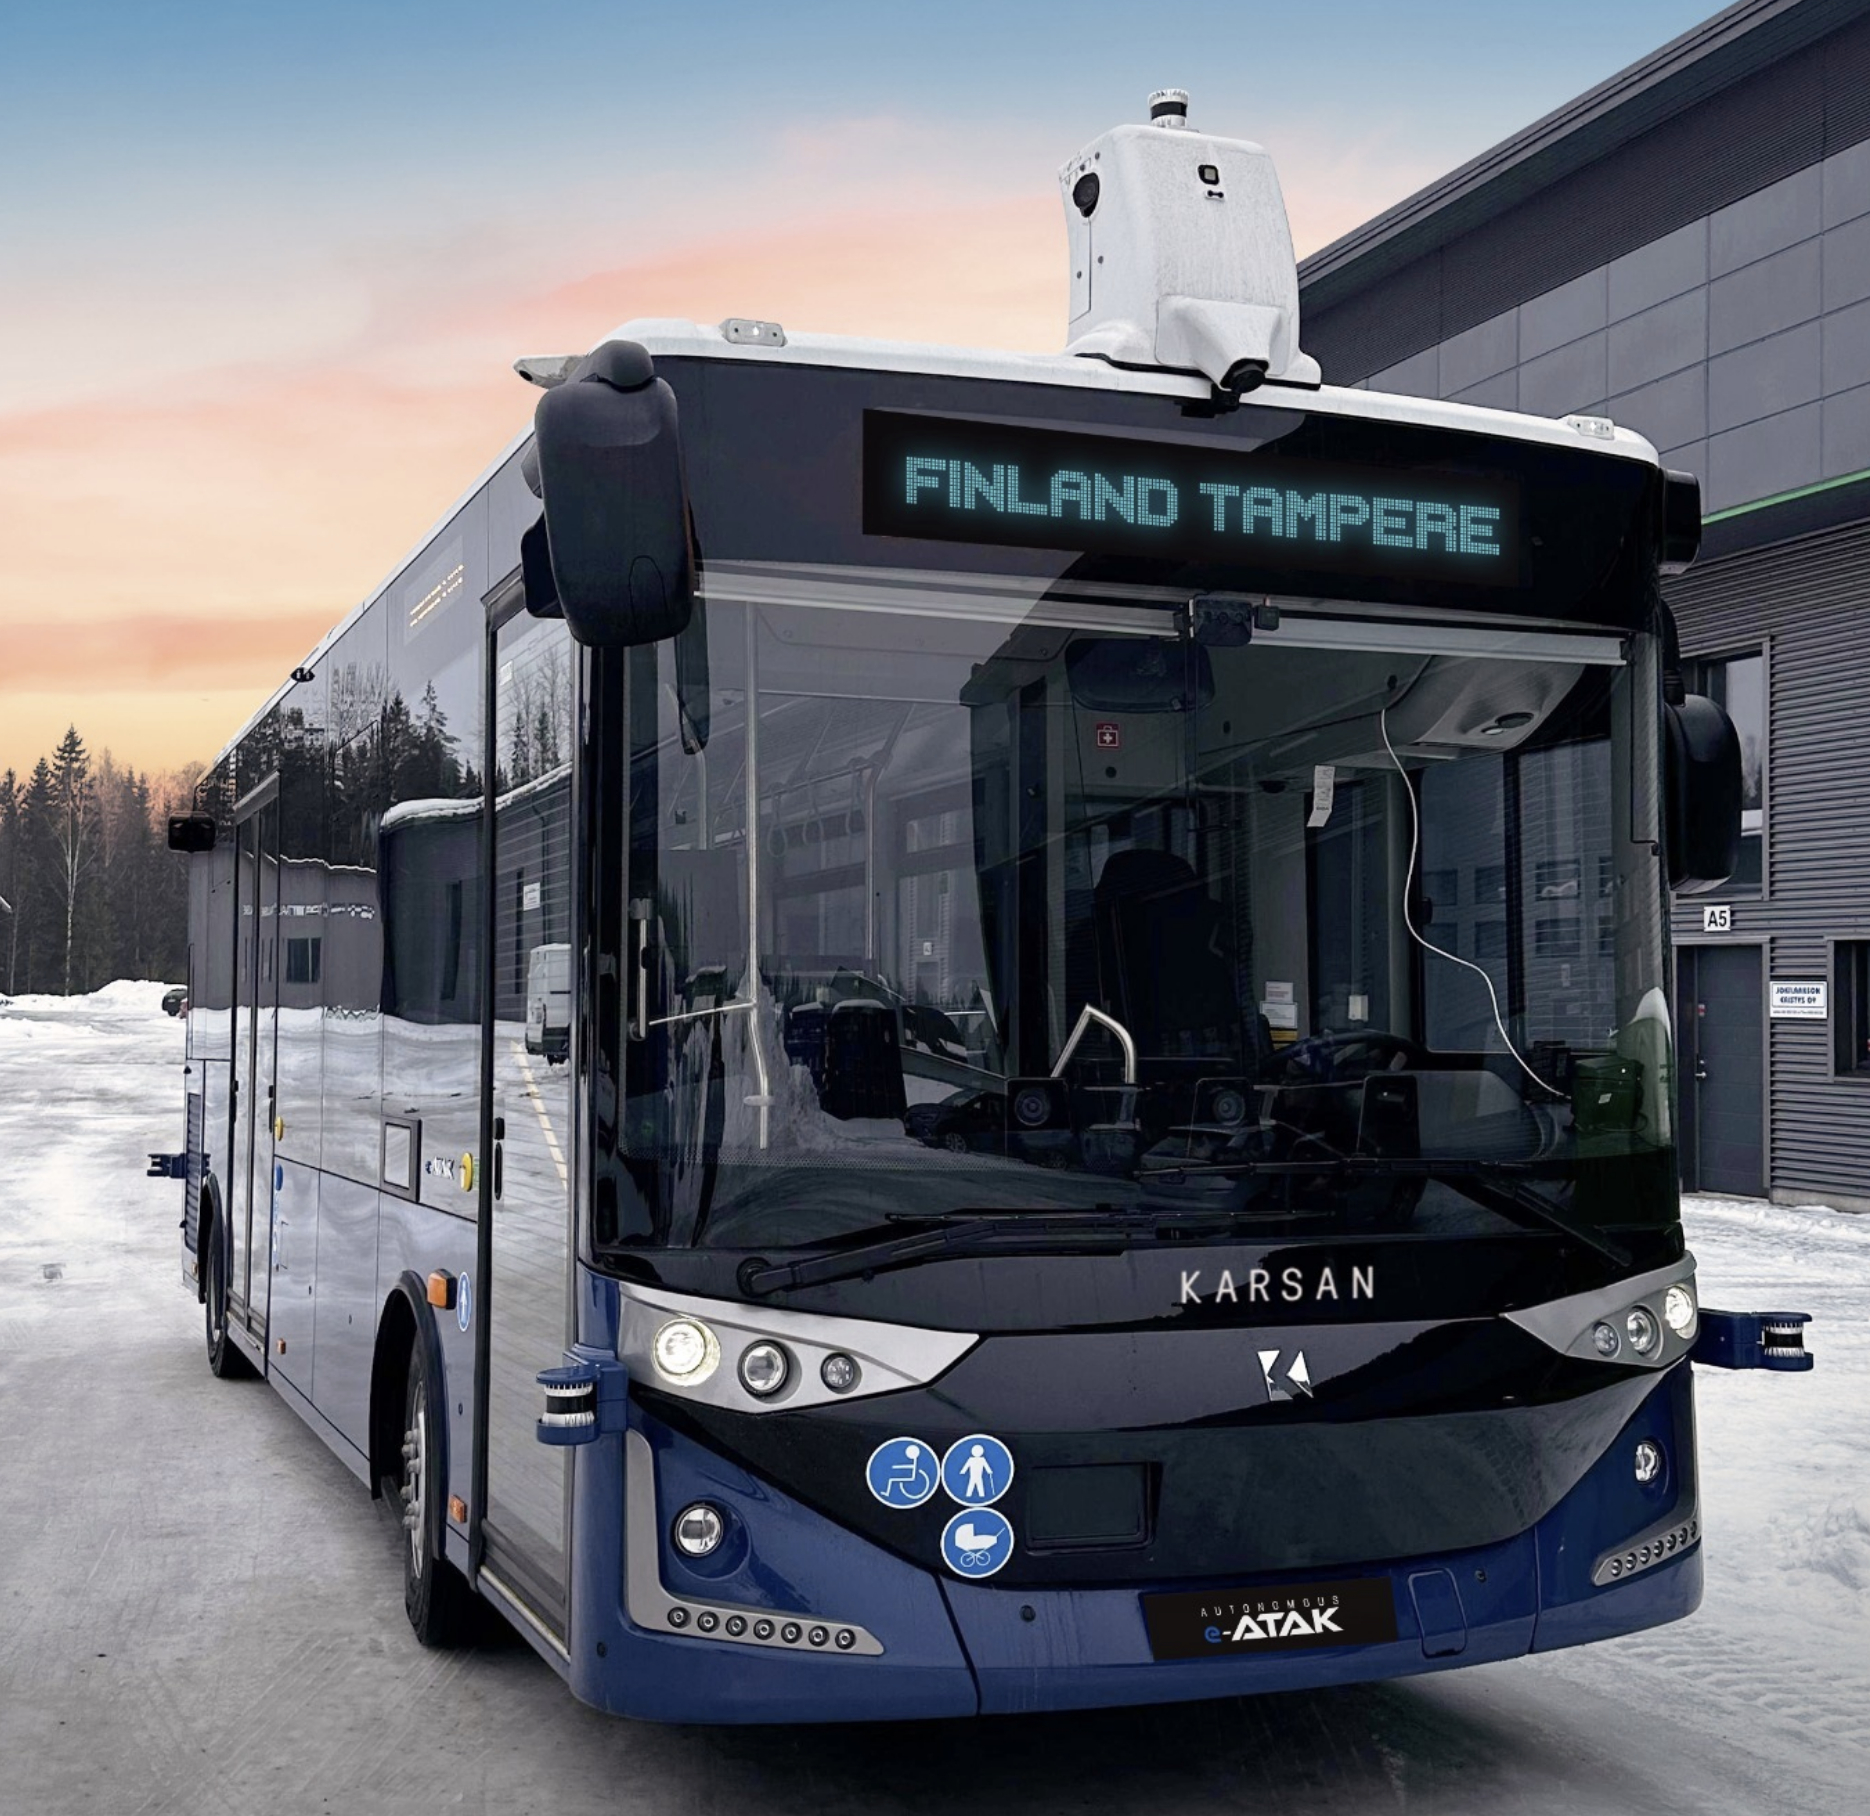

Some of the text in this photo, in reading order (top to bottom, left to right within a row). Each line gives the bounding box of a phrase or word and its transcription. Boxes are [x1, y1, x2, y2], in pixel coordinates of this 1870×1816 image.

[905, 456, 1500, 556] FINLAND TAMPERE
[1707, 910, 1727, 927] A5
[1181, 1266, 1373, 1304] KARSAN
[1200, 1595, 1340, 1618] AUTONOMOUS
[1204, 1606, 1344, 1644] e-ATAK
